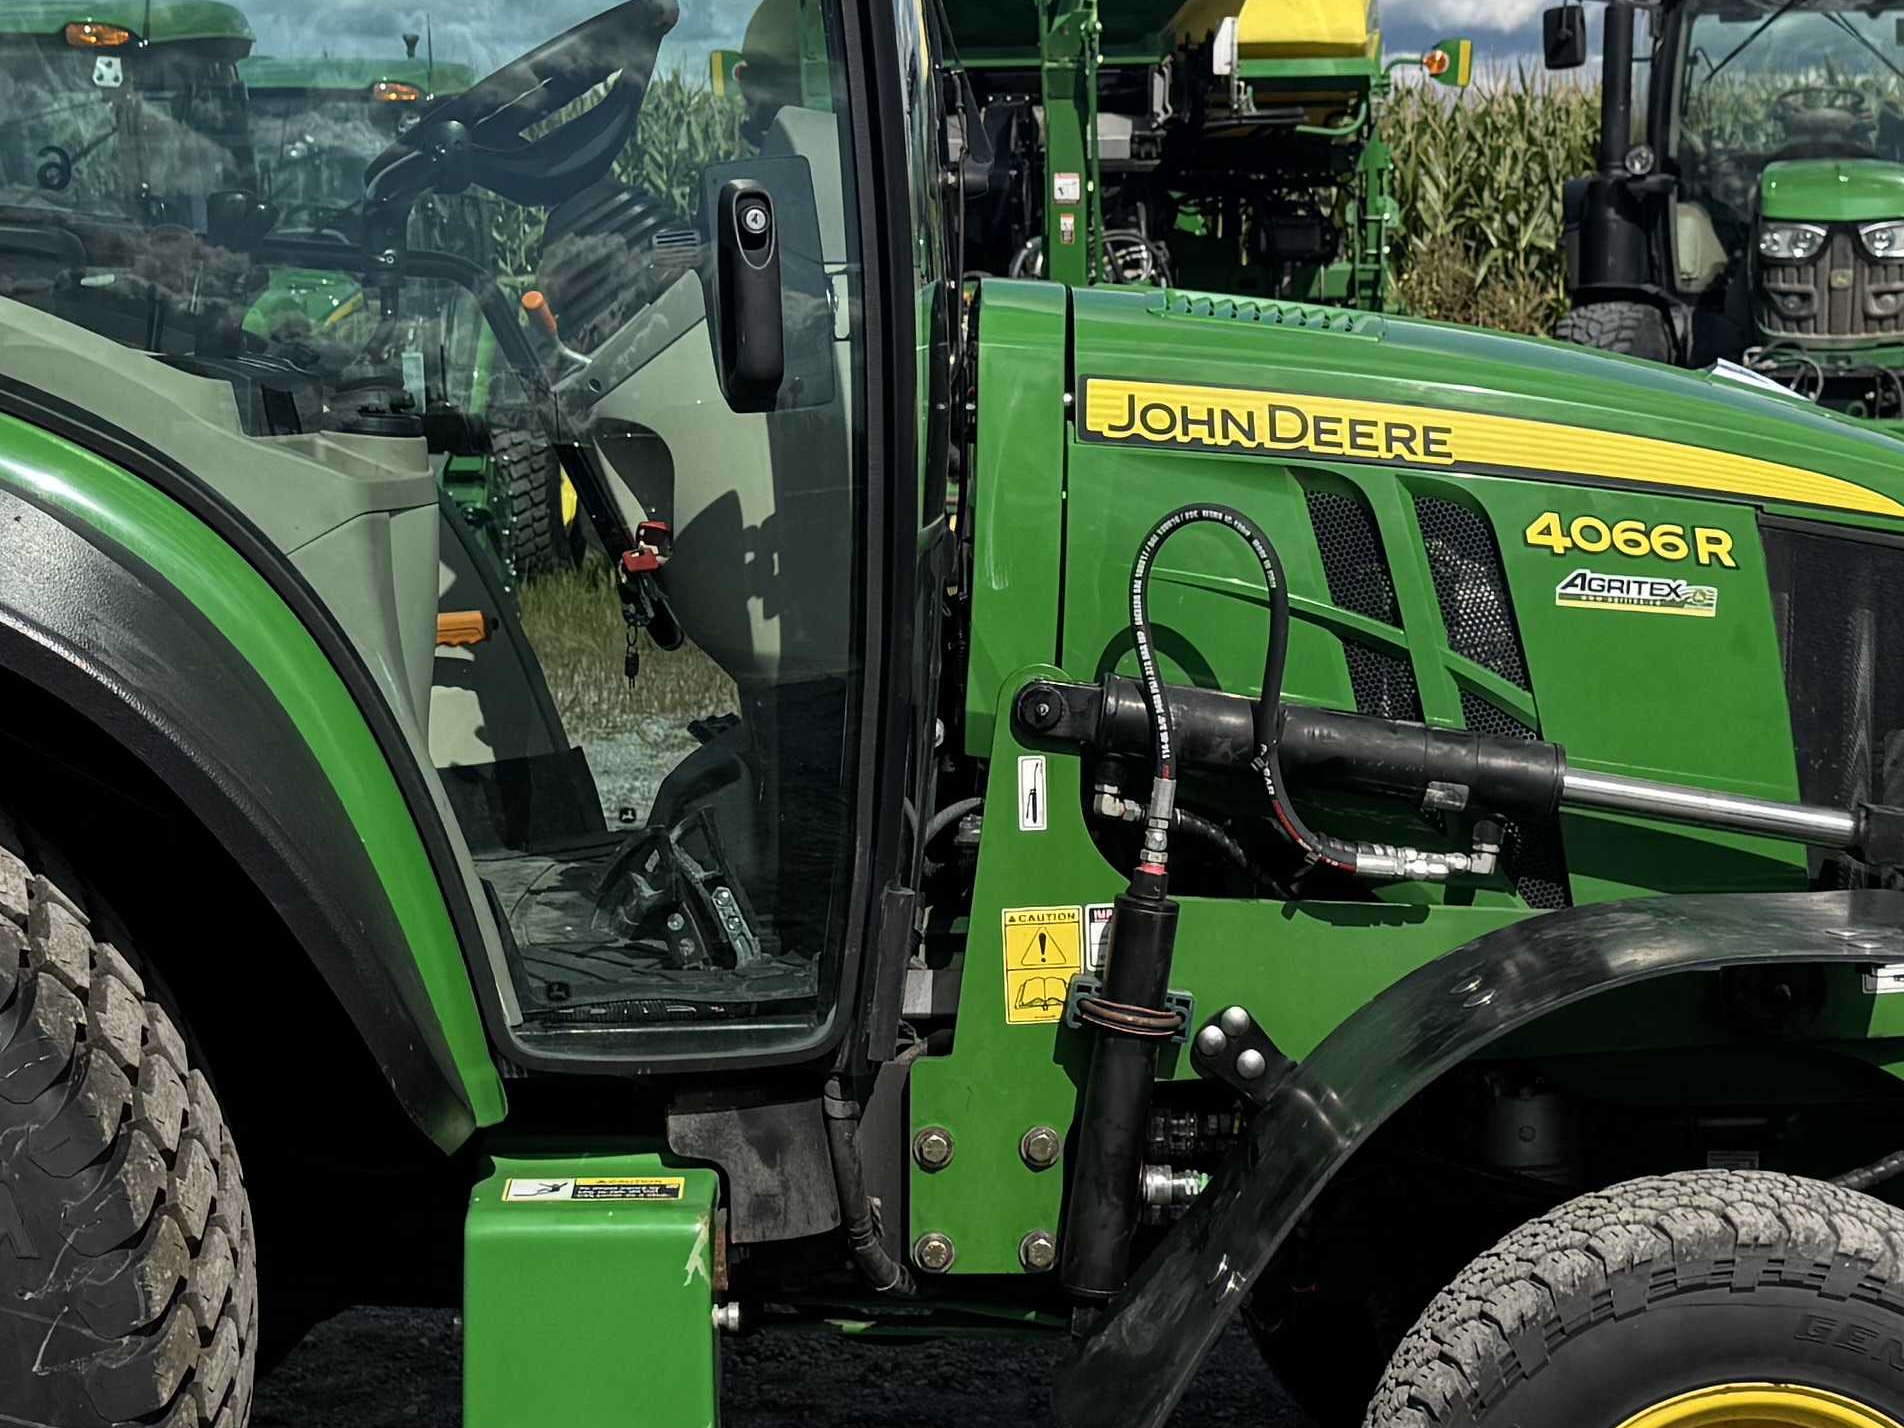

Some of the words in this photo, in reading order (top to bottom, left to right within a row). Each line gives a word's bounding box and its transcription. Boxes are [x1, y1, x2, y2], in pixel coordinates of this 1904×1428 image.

[1107, 393, 1257, 443] JOHN
[1267, 403, 1453, 459] DEERE
[1559, 571, 1684, 599] AGRITEX
[1018, 912, 1076, 923] CAUTION
